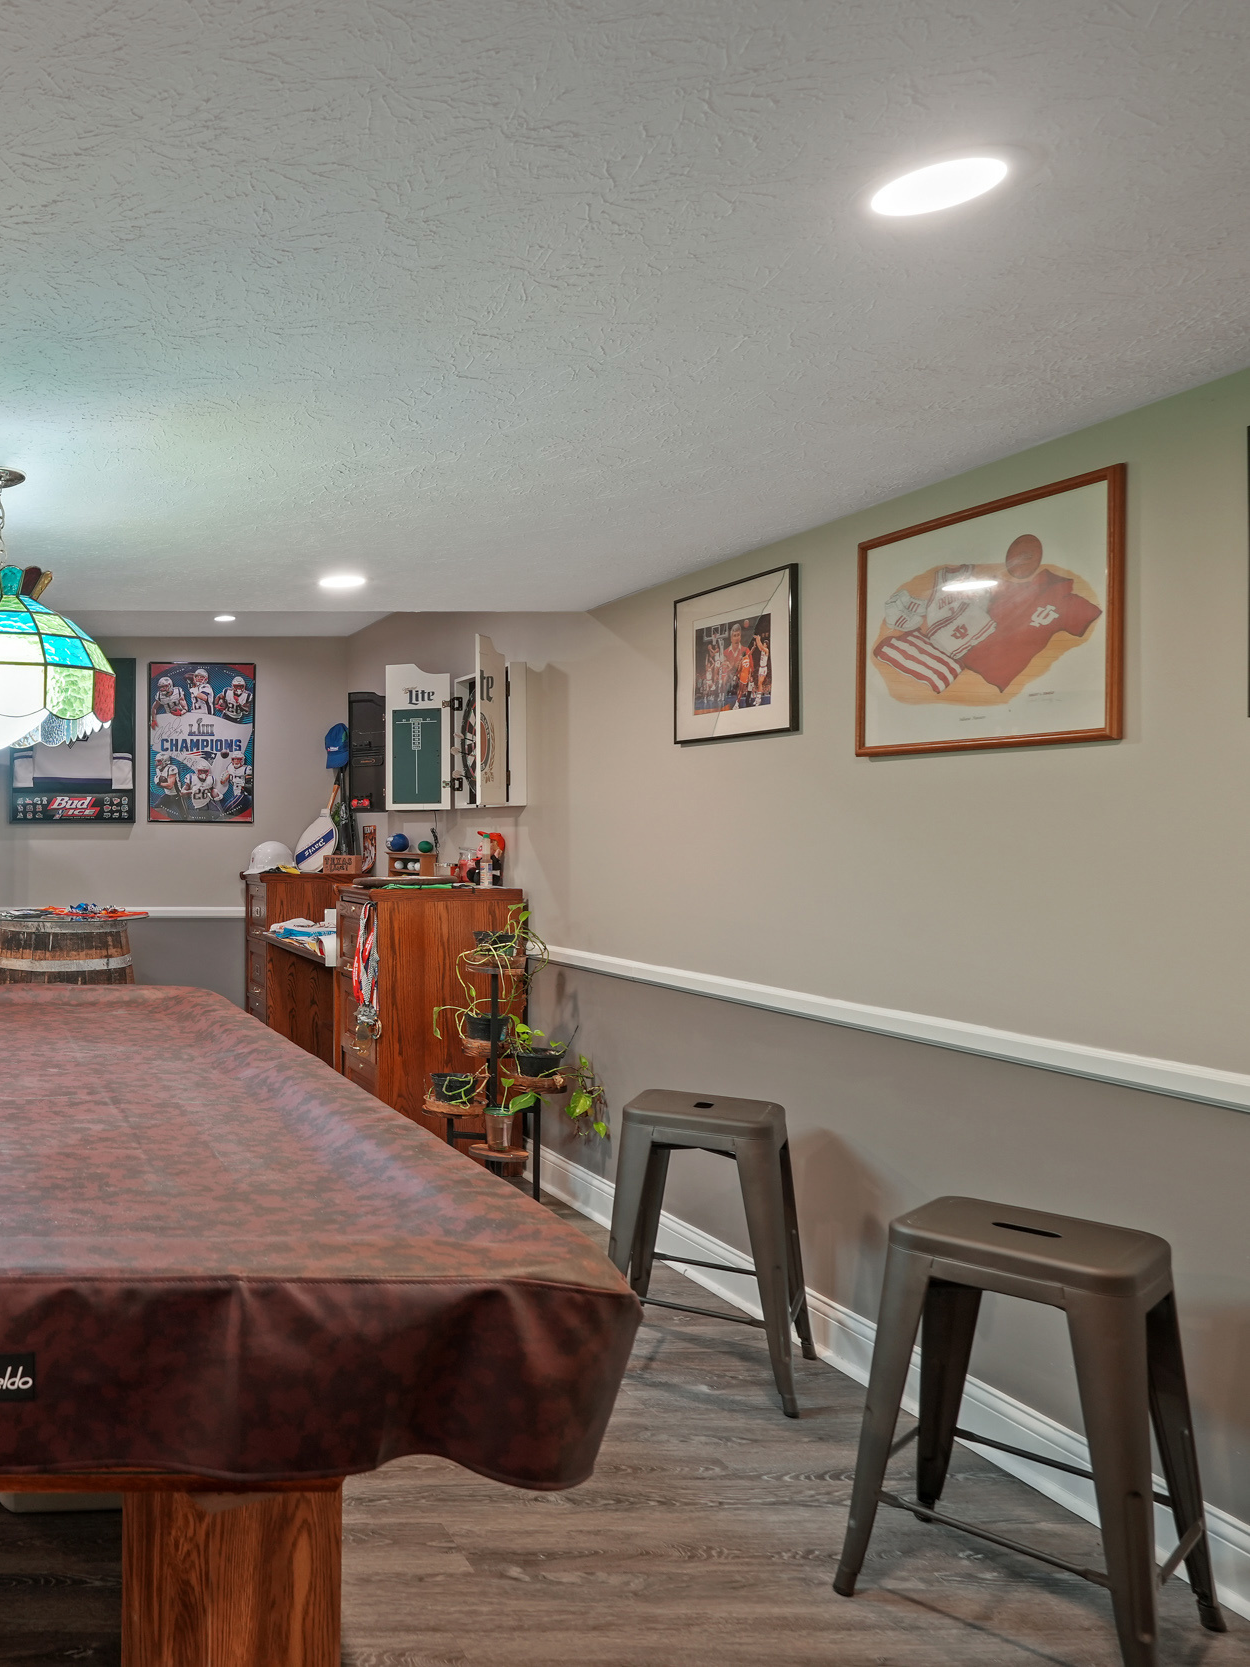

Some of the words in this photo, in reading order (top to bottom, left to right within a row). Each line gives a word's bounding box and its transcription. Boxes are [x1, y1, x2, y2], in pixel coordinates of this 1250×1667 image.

[407, 689, 435, 706] Lite
[160, 738, 242, 753] CHAMPIONS
[51, 796, 93, 809] Bud
[68, 808, 96, 816] ICE
[304, 838, 327, 857] Davis
